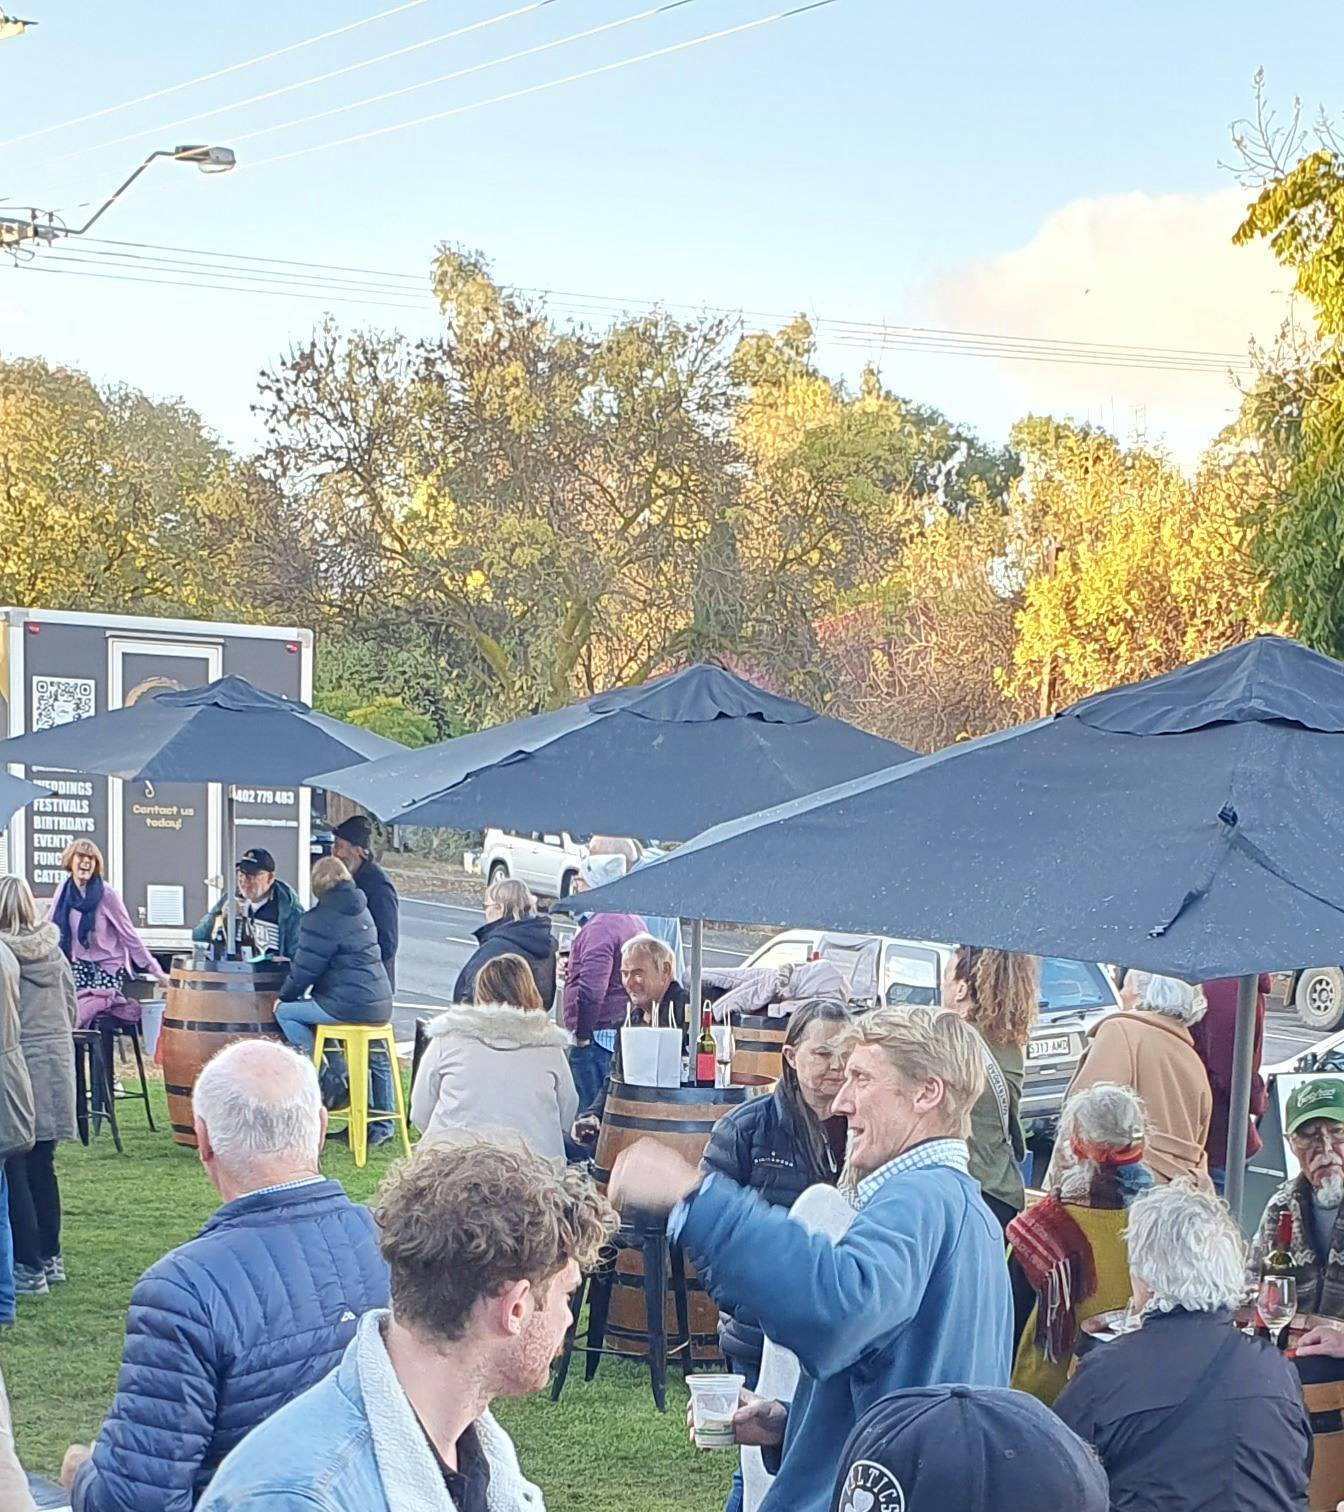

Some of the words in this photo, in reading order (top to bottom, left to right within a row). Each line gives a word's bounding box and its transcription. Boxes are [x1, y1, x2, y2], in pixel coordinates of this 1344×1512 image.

[33, 798, 90, 814] FESTIVALS
[132, 803, 177, 815] Contact
[180, 806, 195, 816] us
[33, 815, 96, 832] BIRTHDAYS
[144, 817, 182, 831] today!
[33, 850, 62, 866] FUNC
